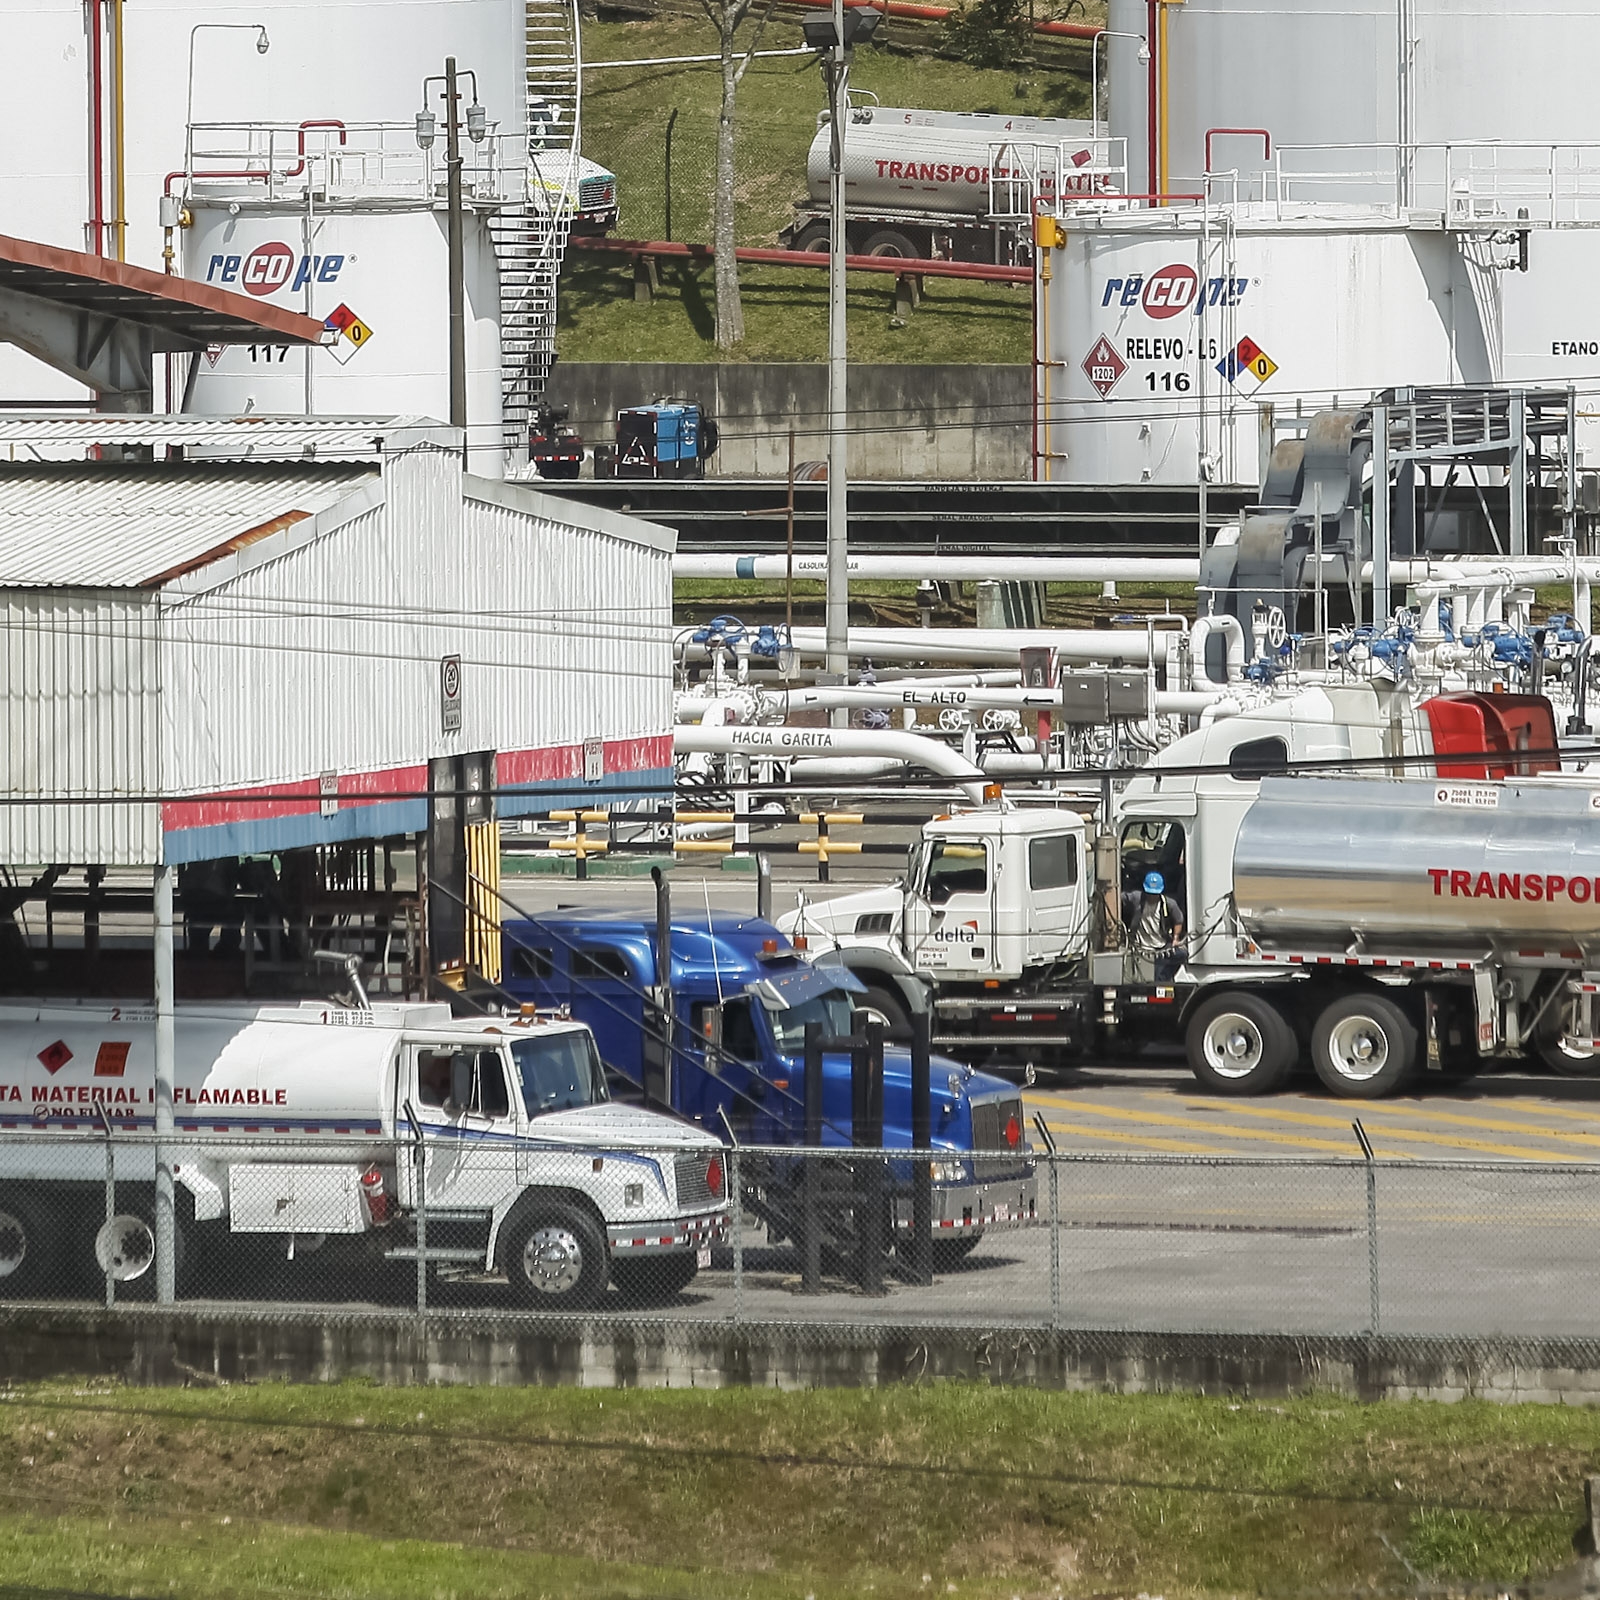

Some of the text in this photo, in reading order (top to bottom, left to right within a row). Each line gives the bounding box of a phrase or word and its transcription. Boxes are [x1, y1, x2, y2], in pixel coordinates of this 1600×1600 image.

[207, 255, 345, 291] recope
[1102, 277, 1248, 315] recope
[352, 325, 361, 341] 0
[248, 345, 289, 363] 117
[1127, 338, 1183, 359] RELEVO
[1093, 367, 1114, 381] 1202
[1258, 359, 1266, 375] 0
[1145, 372, 1190, 392] 116
[903, 691, 967, 703] EL ALTO
[732, 731, 833, 748] HACIA GARITA
[934, 927, 975, 942] delta
[111, 1008, 121, 1020] 2
[320, 1011, 328, 1024] 1
[31, 1086, 141, 1104] MATERIAL
[149, 1088, 287, 1106] IFLAMABLE
[51, 1107, 76, 1118] NO
